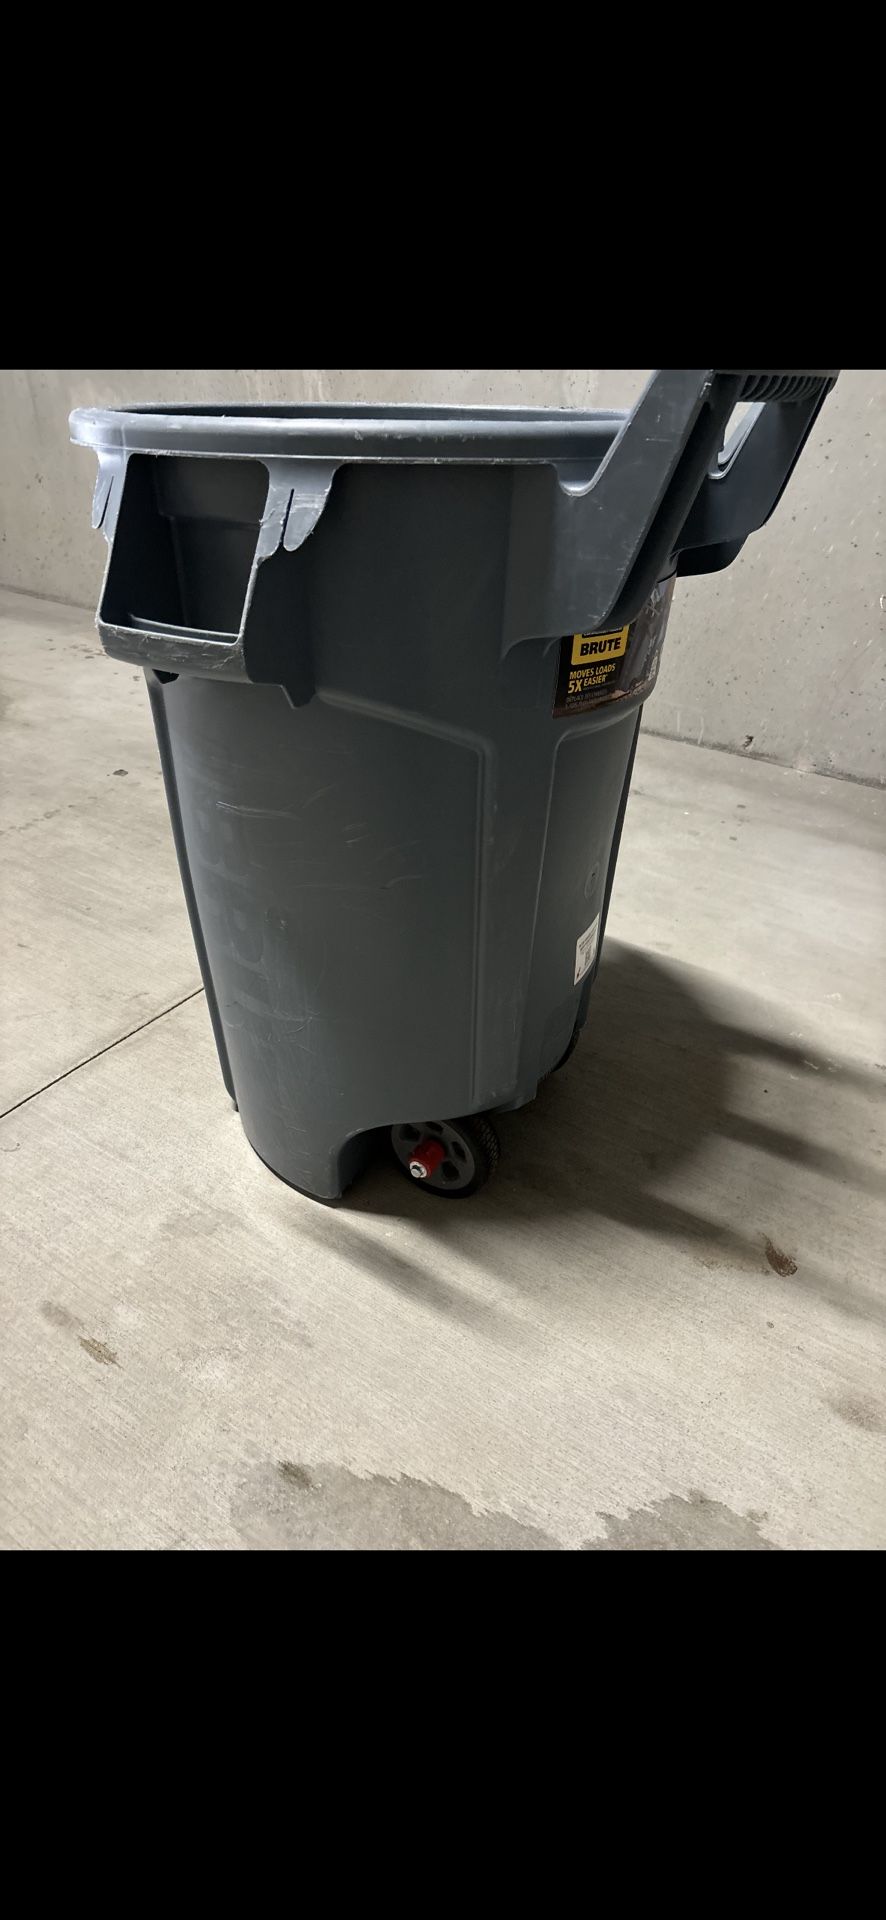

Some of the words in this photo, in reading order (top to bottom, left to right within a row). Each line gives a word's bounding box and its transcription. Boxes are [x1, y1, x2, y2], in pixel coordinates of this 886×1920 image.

[580, 637, 621, 656] BRUTE
[569, 667, 594, 679] MOVES
[595, 663, 616, 676] LOADS
[567, 679, 583, 694] 5X
